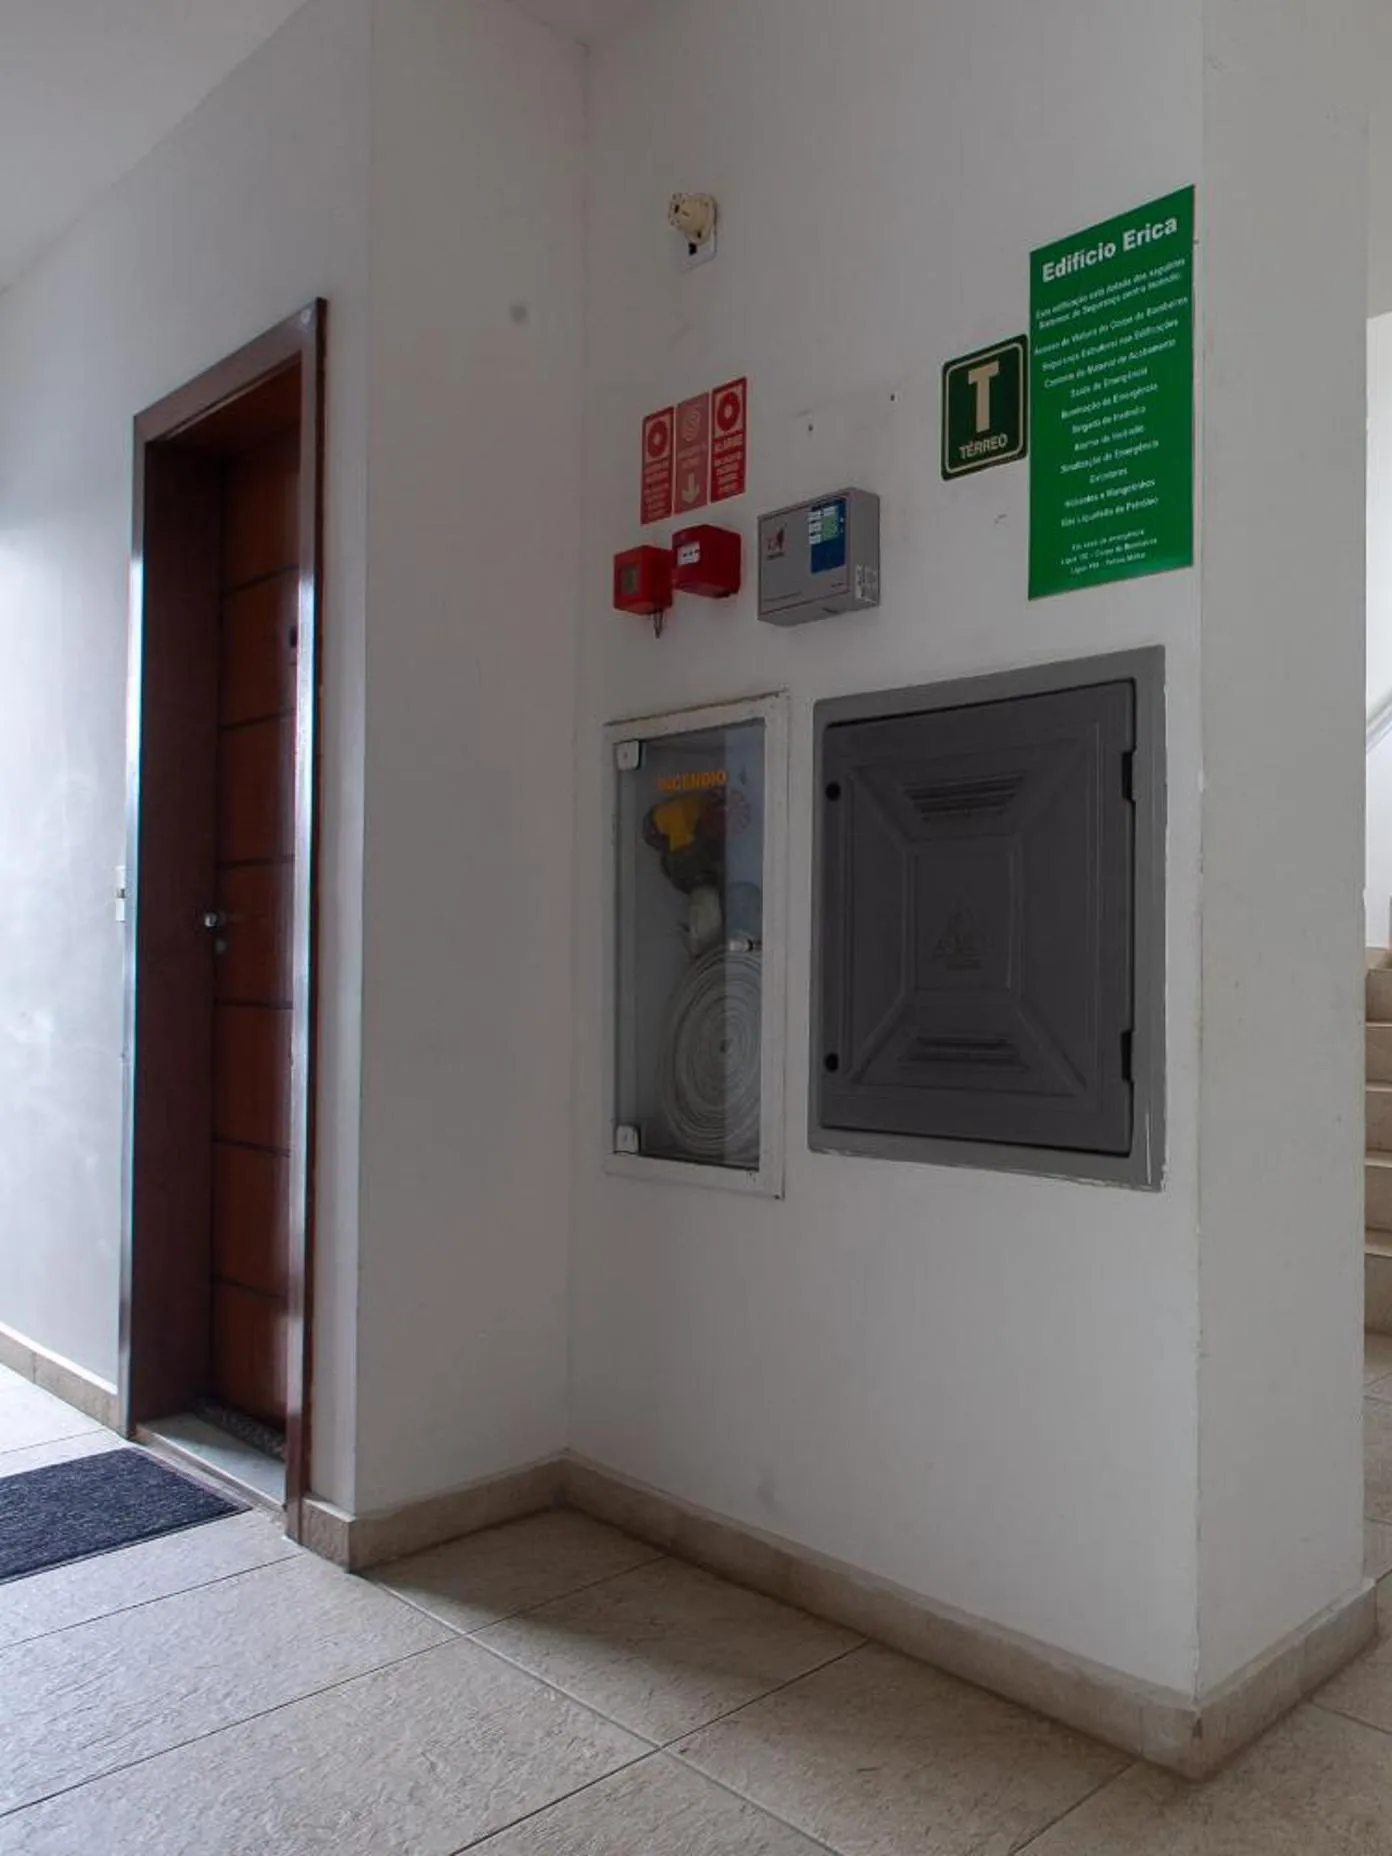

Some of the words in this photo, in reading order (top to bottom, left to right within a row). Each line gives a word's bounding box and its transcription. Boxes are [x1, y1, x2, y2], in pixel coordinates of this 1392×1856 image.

[1123, 216, 1178, 252] Erica
[968, 360, 999, 433] T
[959, 433, 1009, 460] TÉRREO
